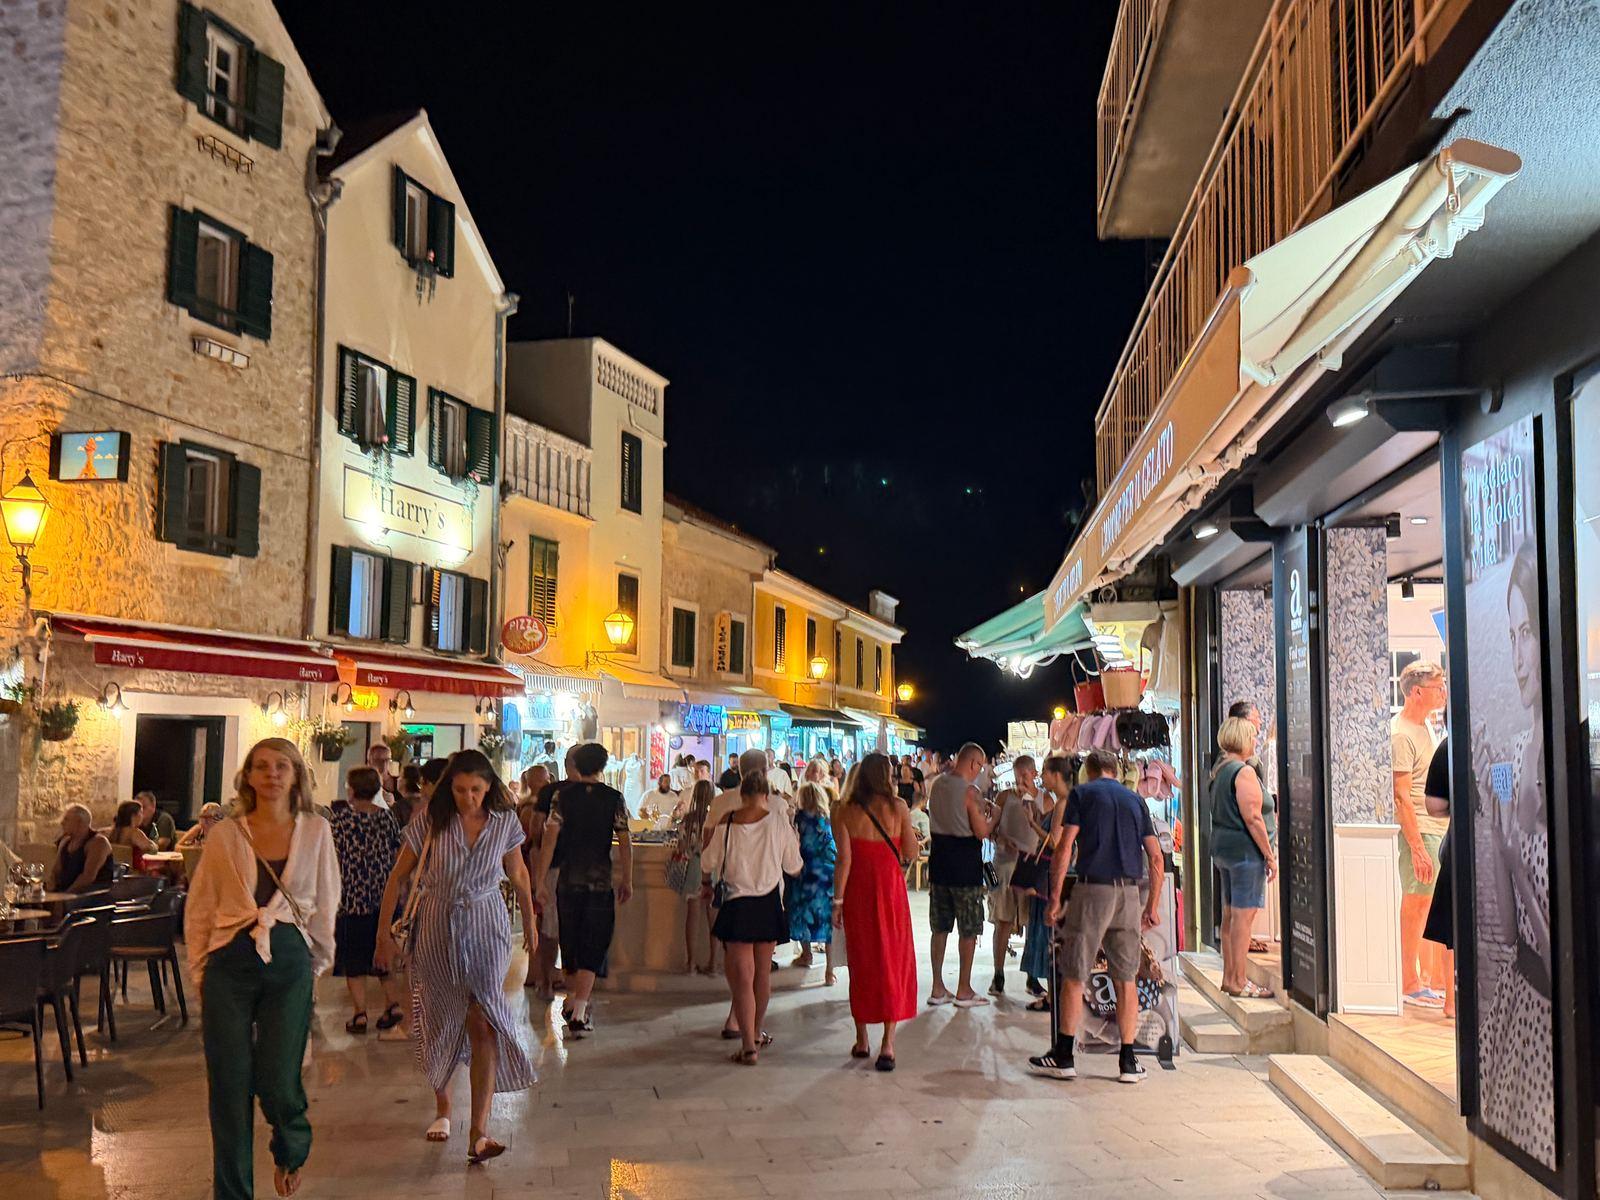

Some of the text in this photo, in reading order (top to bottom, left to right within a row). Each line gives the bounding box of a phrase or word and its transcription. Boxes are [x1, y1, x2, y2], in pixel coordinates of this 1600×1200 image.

[1142, 420, 1174, 501] GELATO
[1481, 454, 1522, 500] gelato
[380, 486, 446, 535] Harry's
[1469, 488, 1523, 536] la dolce
[1471, 536, 1497, 570] vita
[509, 618, 539, 632] PIZZA
[111, 649, 145, 667] Harry's
[299, 666, 323, 681] Harry's
[366, 672, 390, 685] Harry's
[1092, 973, 1117, 1004] a
[1098, 1003, 1117, 1012] ROM
